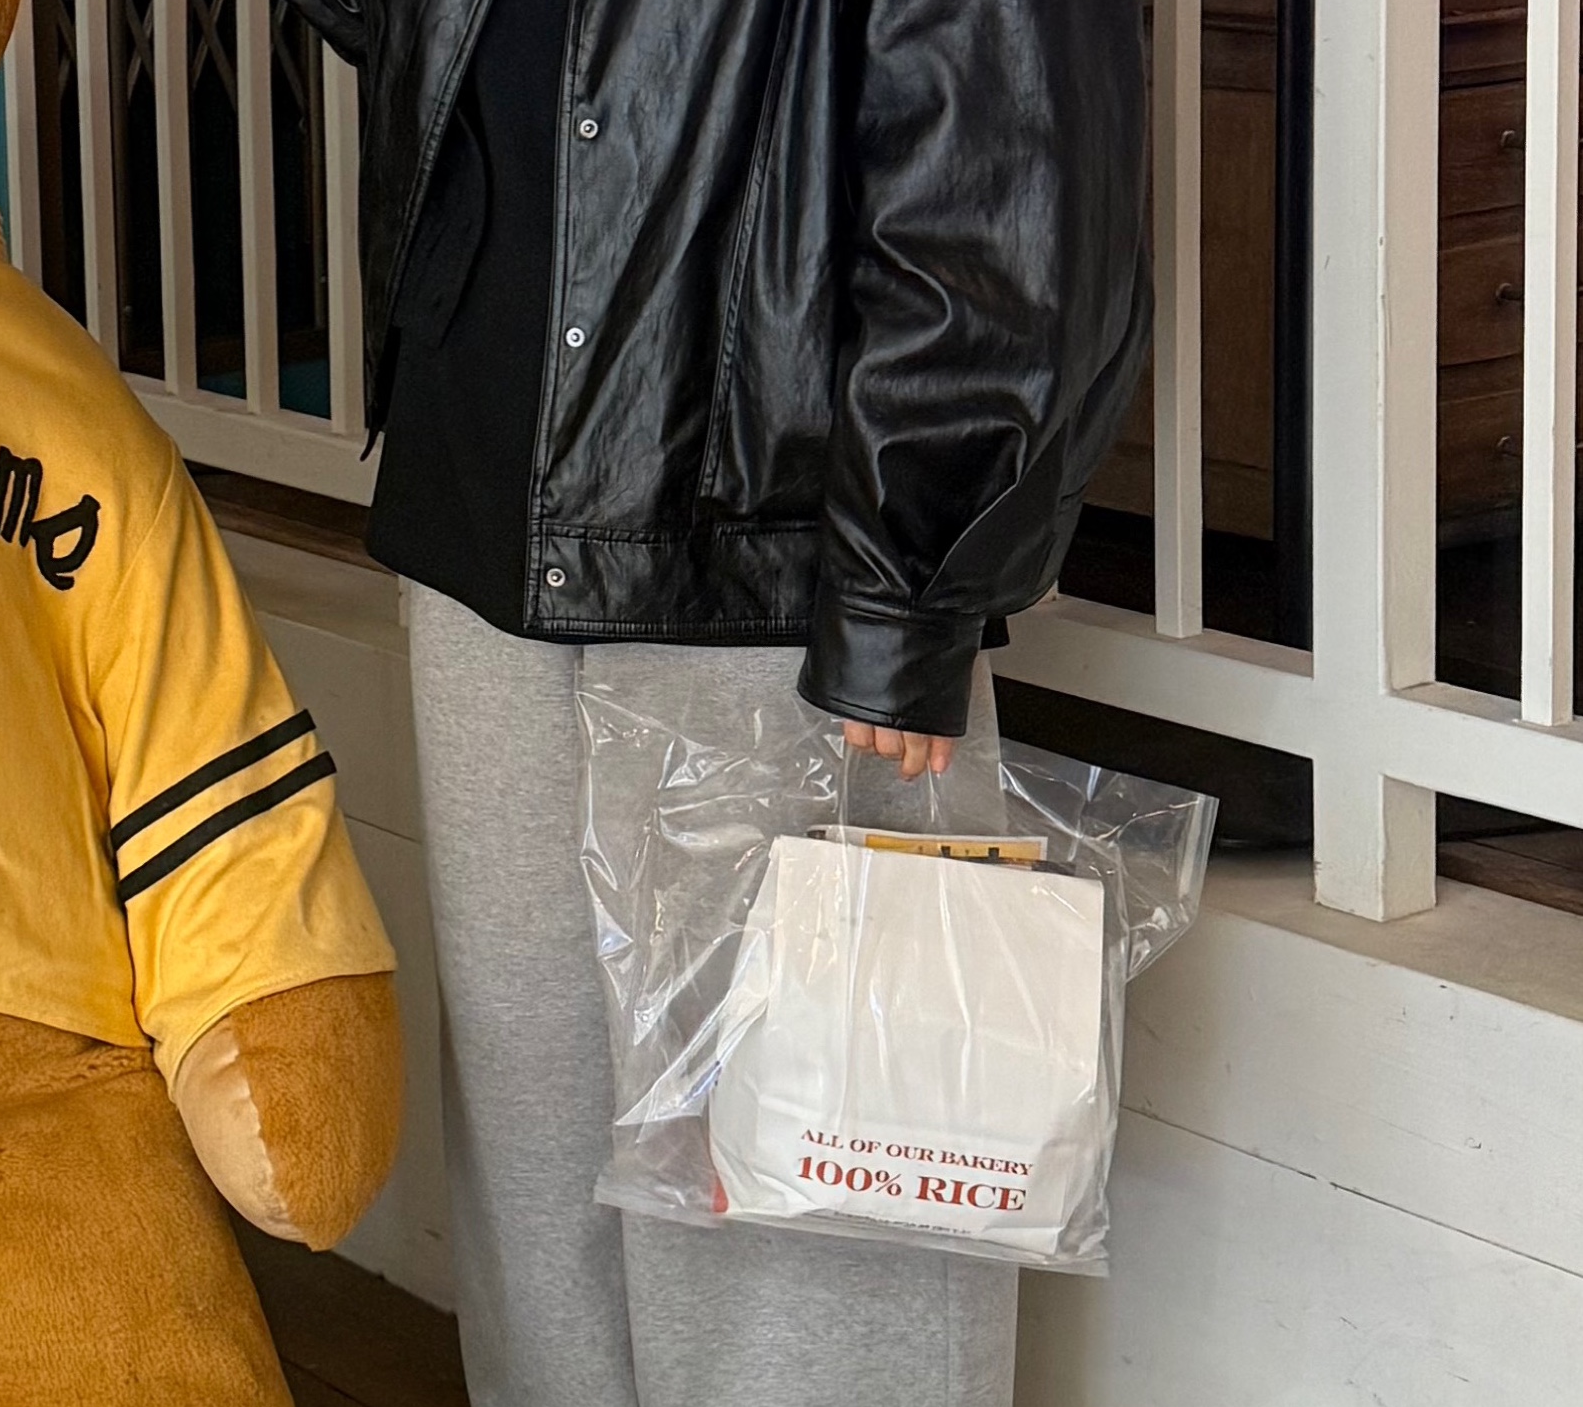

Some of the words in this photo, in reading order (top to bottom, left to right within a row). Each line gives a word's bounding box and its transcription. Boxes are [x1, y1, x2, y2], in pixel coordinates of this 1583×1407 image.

[801, 1128, 844, 1149] ALL
[849, 1138, 882, 1154] OF
[885, 1144, 934, 1163] OUR
[939, 1150, 1034, 1176] BAKERY
[797, 1156, 903, 1197] 100%
[915, 1175, 1027, 1211] RICE
